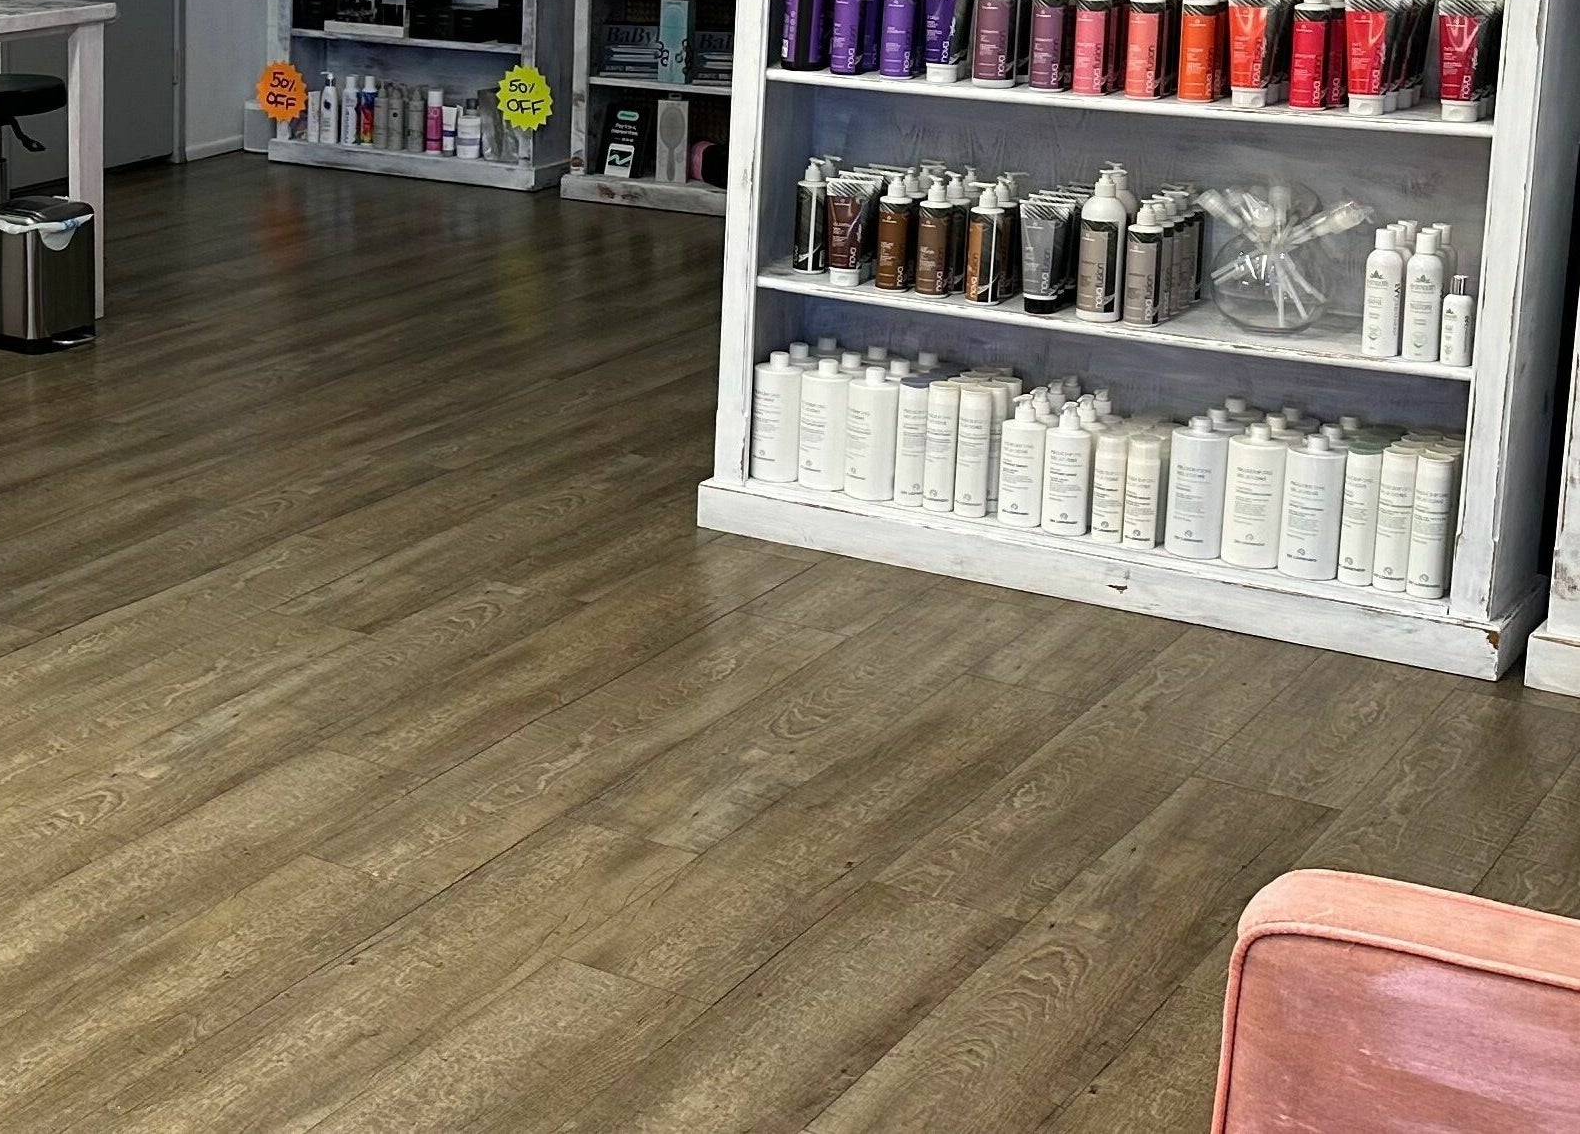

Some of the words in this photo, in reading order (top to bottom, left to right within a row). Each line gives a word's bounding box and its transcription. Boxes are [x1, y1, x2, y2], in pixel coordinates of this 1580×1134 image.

[997, 55, 1006, 77] nova
[1051, 63, 1059, 85] nova
[1252, 63, 1261, 85] nova
[270, 71, 297, 91] 50%
[509, 79, 535, 94] 50%
[1093, 68, 1101, 90] nova
[1145, 71, 1154, 93] nova
[1372, 70, 1380, 93] nova
[1462, 75, 1471, 99] nova
[266, 93, 297, 110] OFF
[1312, 81, 1320, 104] nova
[507, 99, 544, 115] OFF
[896, 266, 904, 287] nova
[1040, 272, 1050, 293] nova
[1095, 287, 1104, 309] nova
[1145, 299, 1153, 320] nova
